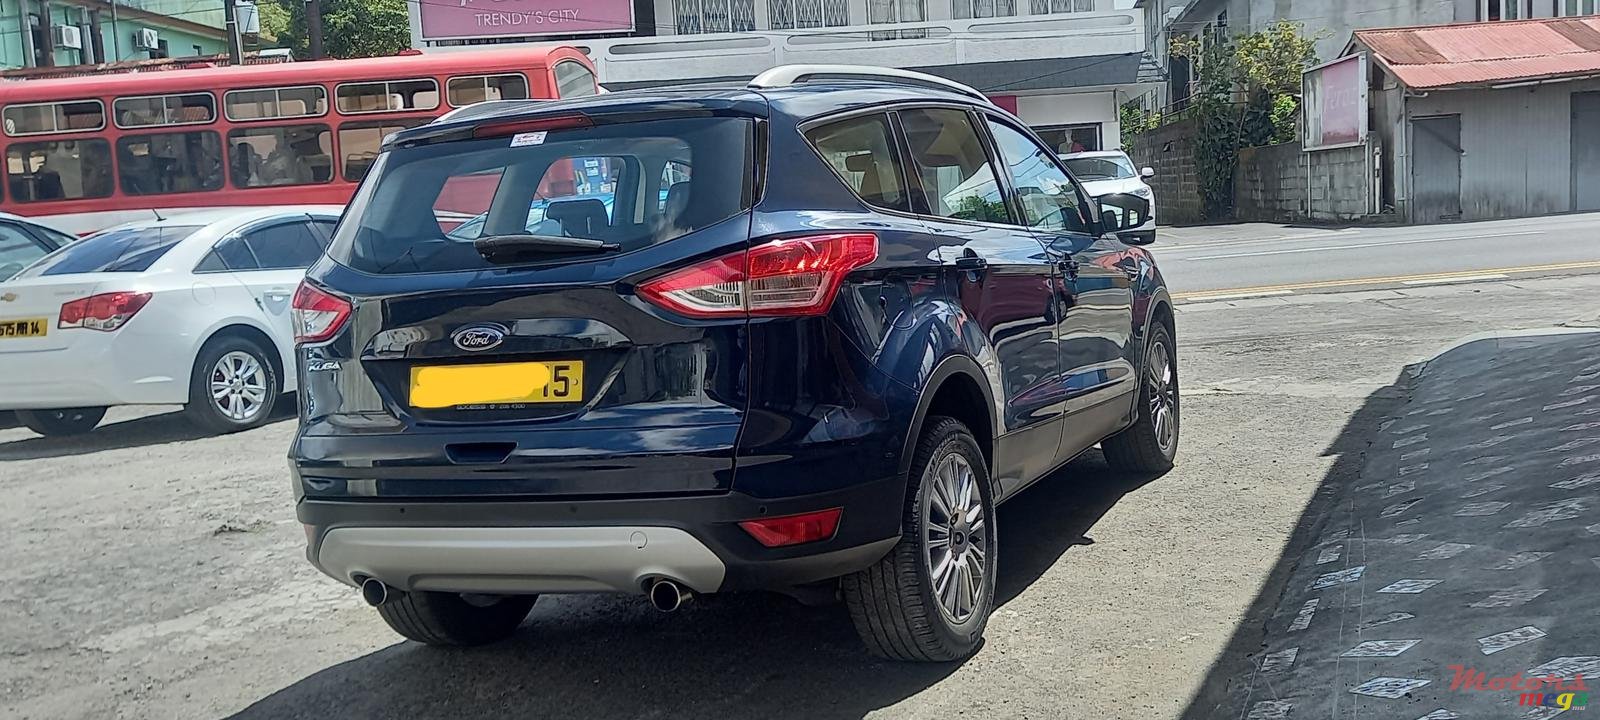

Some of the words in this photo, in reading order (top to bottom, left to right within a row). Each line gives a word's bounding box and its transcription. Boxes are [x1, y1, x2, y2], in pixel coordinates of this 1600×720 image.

[475, 10, 544, 26] TRENDY'S
[548, 8, 579, 24] CITY
[463, 331, 491, 346] Ford
[308, 360, 343, 372] KUGA
